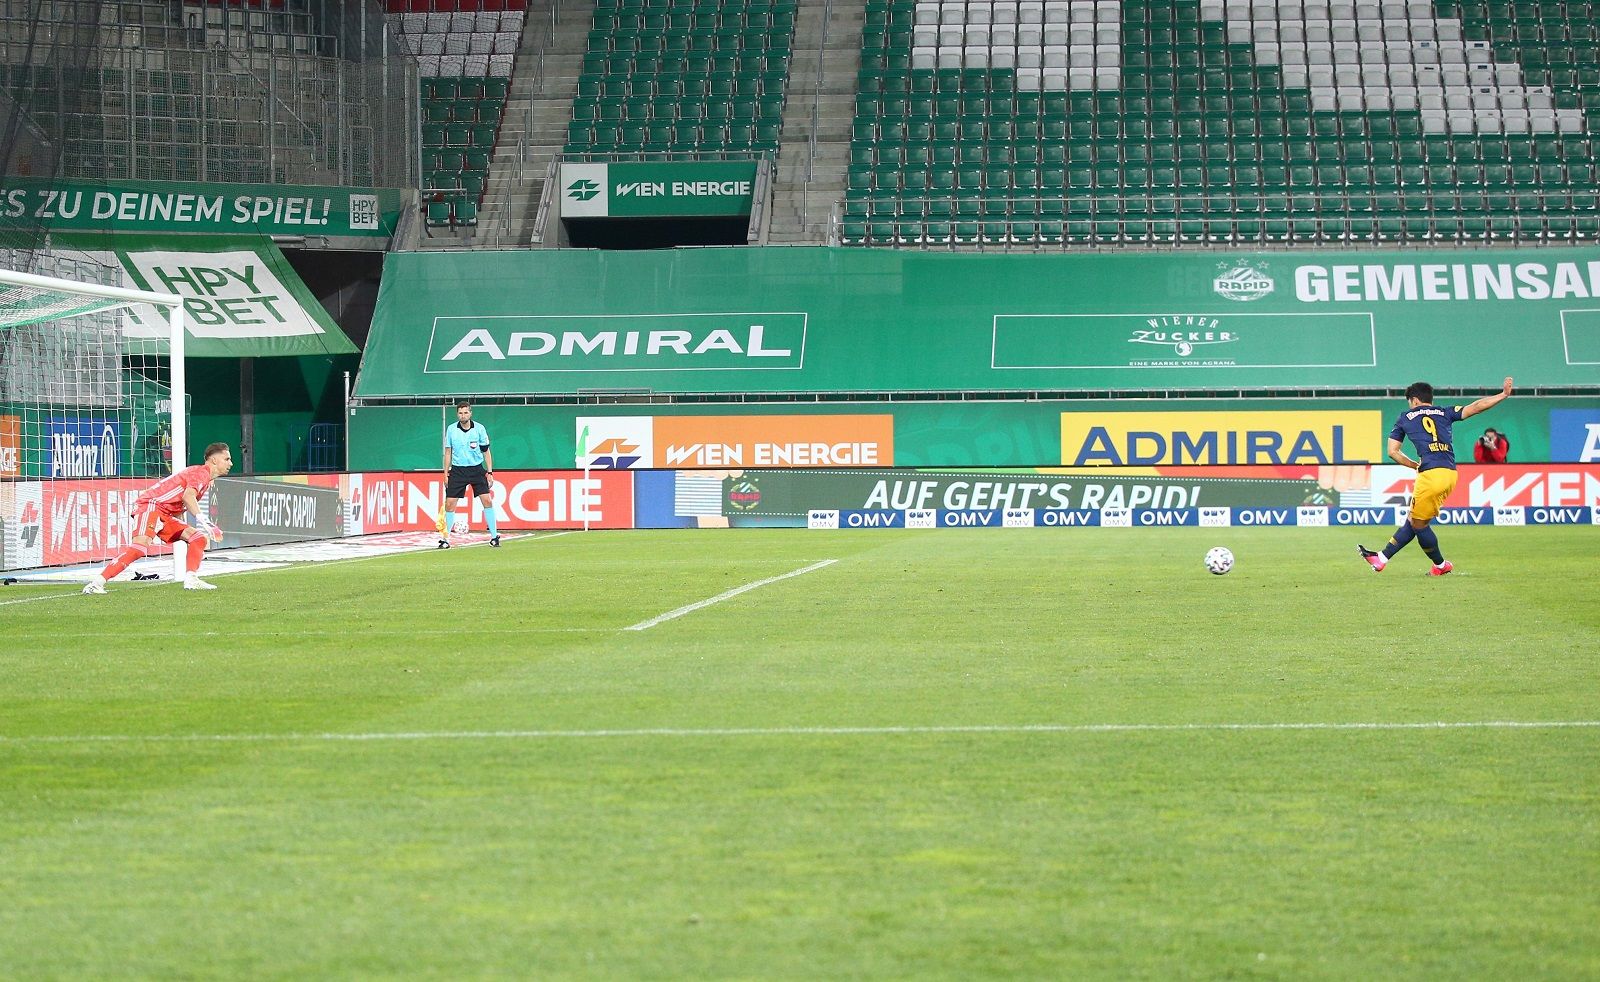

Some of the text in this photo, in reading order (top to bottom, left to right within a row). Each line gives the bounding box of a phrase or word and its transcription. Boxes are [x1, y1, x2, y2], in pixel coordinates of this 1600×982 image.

[616, 181, 751, 197] WIEN ENERGIE
[35, 190, 82, 219] ZU
[92, 192, 223, 223] DEINEM
[231, 195, 331, 225] SPIEL!
[352, 200, 376, 212] HPY
[352, 212, 375, 224] BET
[152, 265, 261, 296] HPY
[1218, 281, 1270, 290] RAPID
[1294, 261, 1600, 303] GEMEINSA
[183, 295, 287, 325] BET
[1147, 316, 1219, 329] WIENER
[441, 325, 792, 362] ADMIRAL
[1128, 330, 1234, 344] ZUCKER
[1421, 415, 1438, 442] 9
[1073, 425, 1369, 465] ADMIRAL
[53, 433, 99, 477] Allianz
[667, 443, 878, 465] WIEN ENERGIE
[366, 480, 394, 526] WIEN
[863, 480, 938, 510] AUF
[1081, 484, 1200, 509] RAPID!
[242, 490, 261, 525] AUF
[292, 495, 316, 529] RAPID!
[1238, 510, 1288, 525] OMV
[1336, 509, 1386, 524] OMV
[1436, 509, 1484, 524] OMV
[1533, 508, 1581, 524] OMV
[50, 490, 101, 554] WIEN
[847, 513, 897, 527] OMV
[944, 512, 994, 526] OMV
[1042, 511, 1092, 525] OMV
[1140, 511, 1189, 525] OMV
